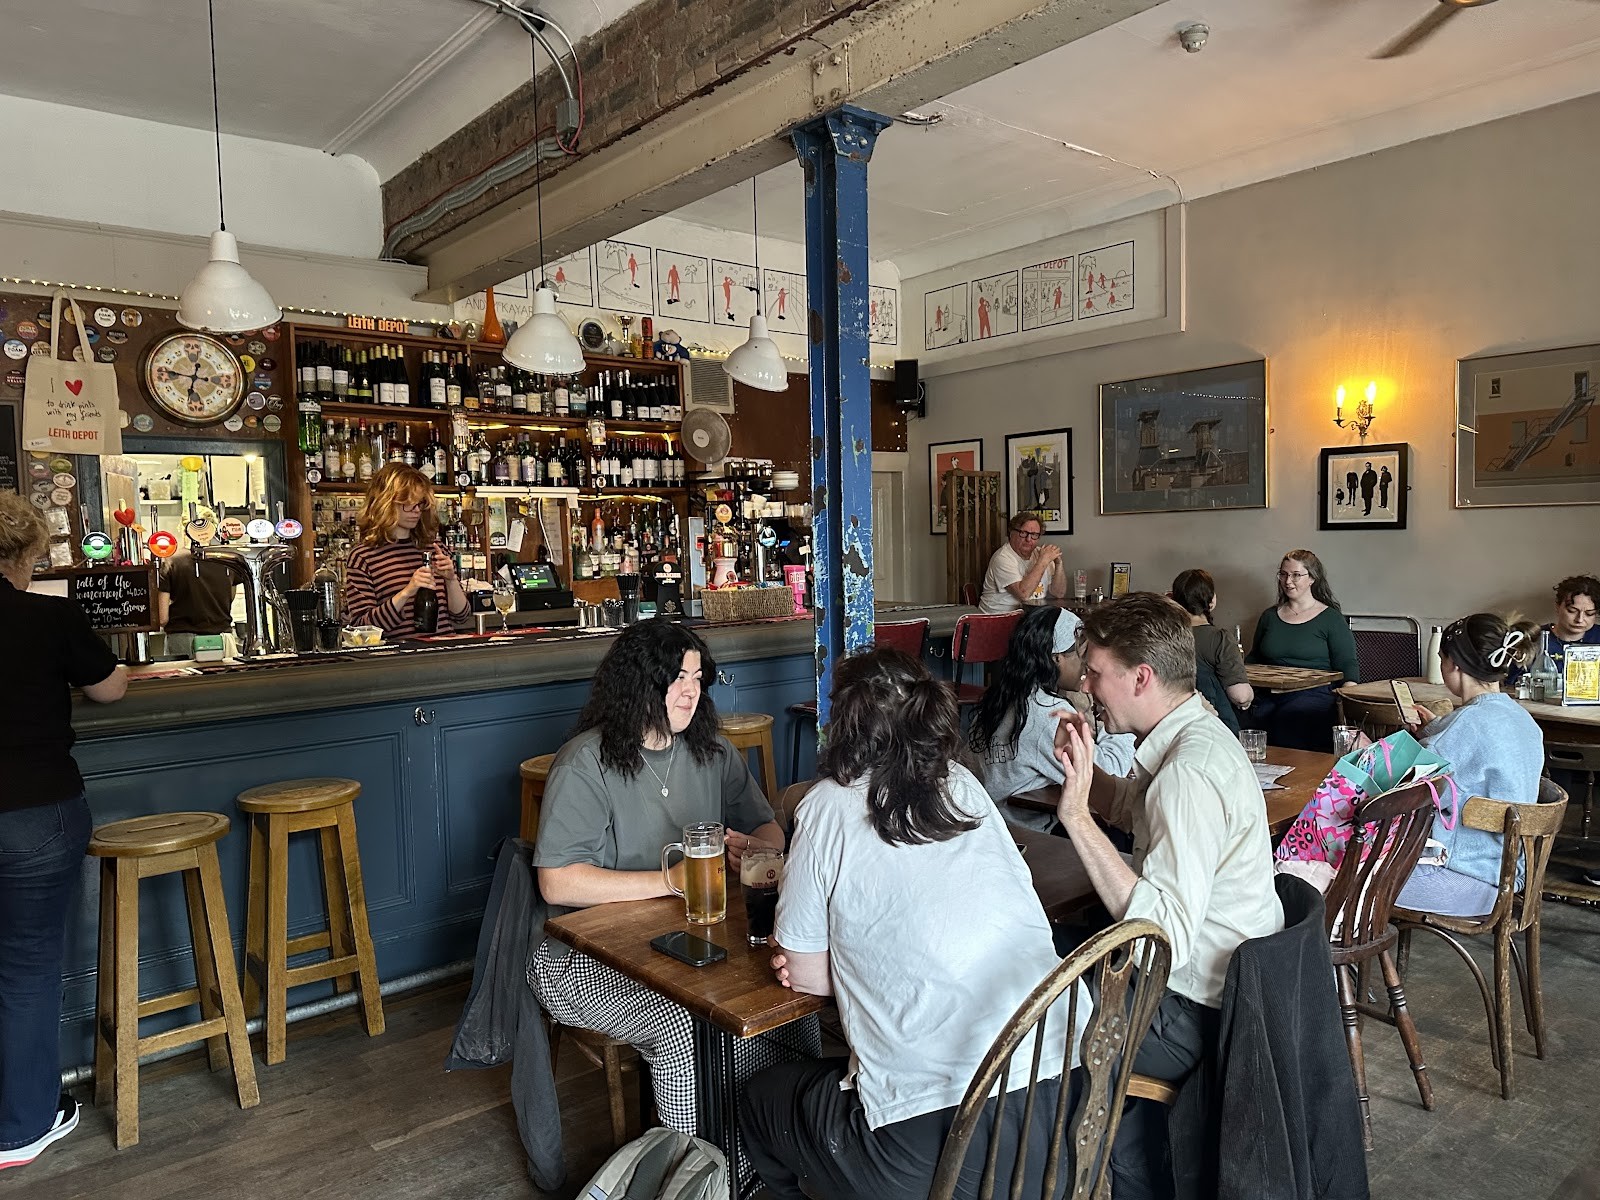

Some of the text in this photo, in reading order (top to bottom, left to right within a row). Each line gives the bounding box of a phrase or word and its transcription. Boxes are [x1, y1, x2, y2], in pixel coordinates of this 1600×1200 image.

[347, 316, 409, 333] LEITH DEPOT
[59, 401, 75, 409] drink
[79, 400, 95, 412] pints
[79, 409, 101, 421] friends
[48, 427, 98, 440] LEITH DEPOT
[97, 574, 108, 591] of
[92, 602, 121, 615] Famous
